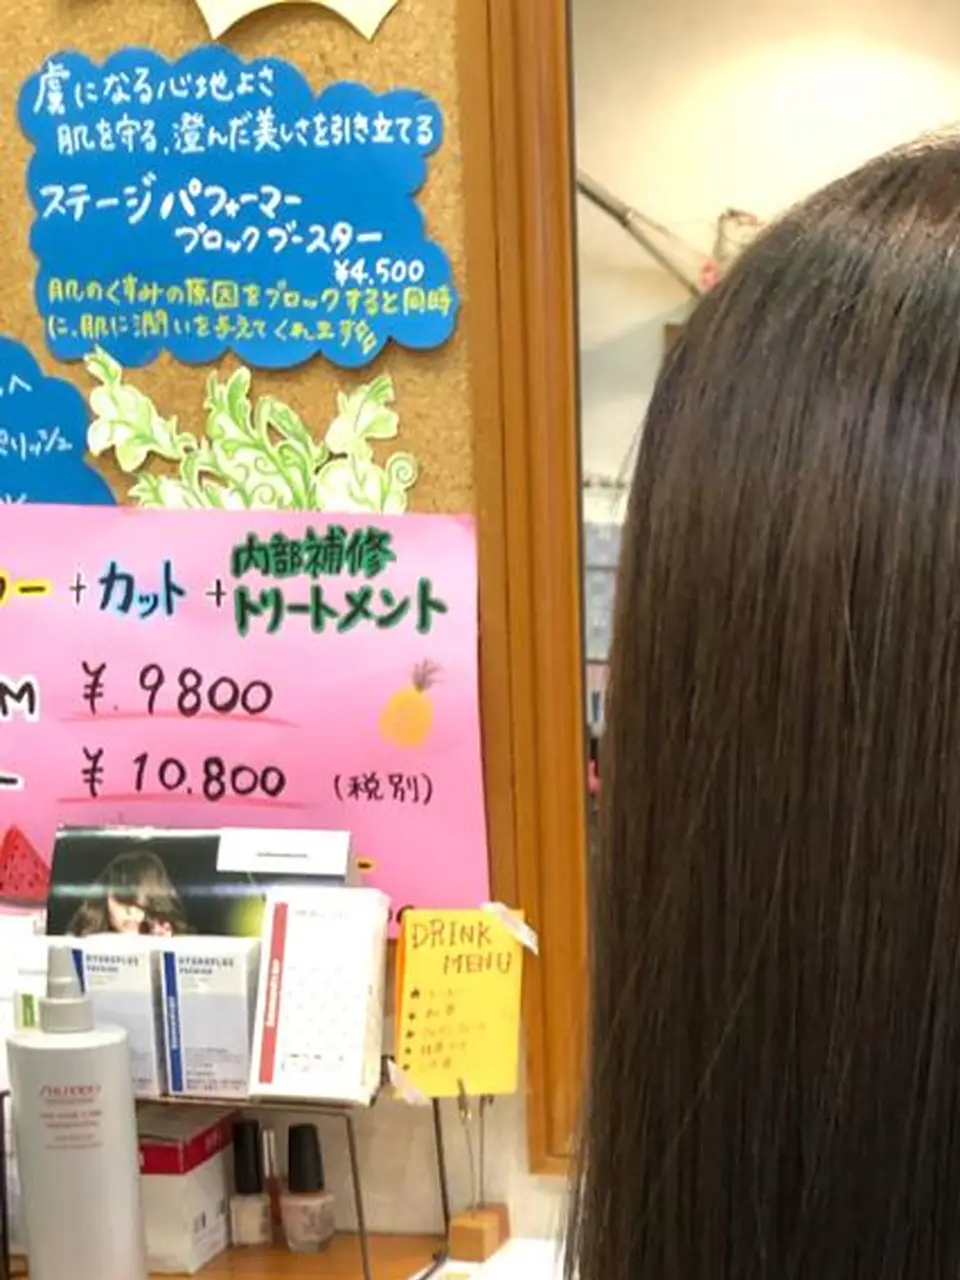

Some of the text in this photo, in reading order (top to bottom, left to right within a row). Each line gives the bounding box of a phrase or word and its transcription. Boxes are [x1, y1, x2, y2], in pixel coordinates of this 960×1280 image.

[230, 525, 398, 580] 内部補修
[98, 560, 187, 619] カット
[233, 578, 448, 636] トリートメント
[411, 918, 493, 949] DRINK
[443, 951, 513, 975] MENU
